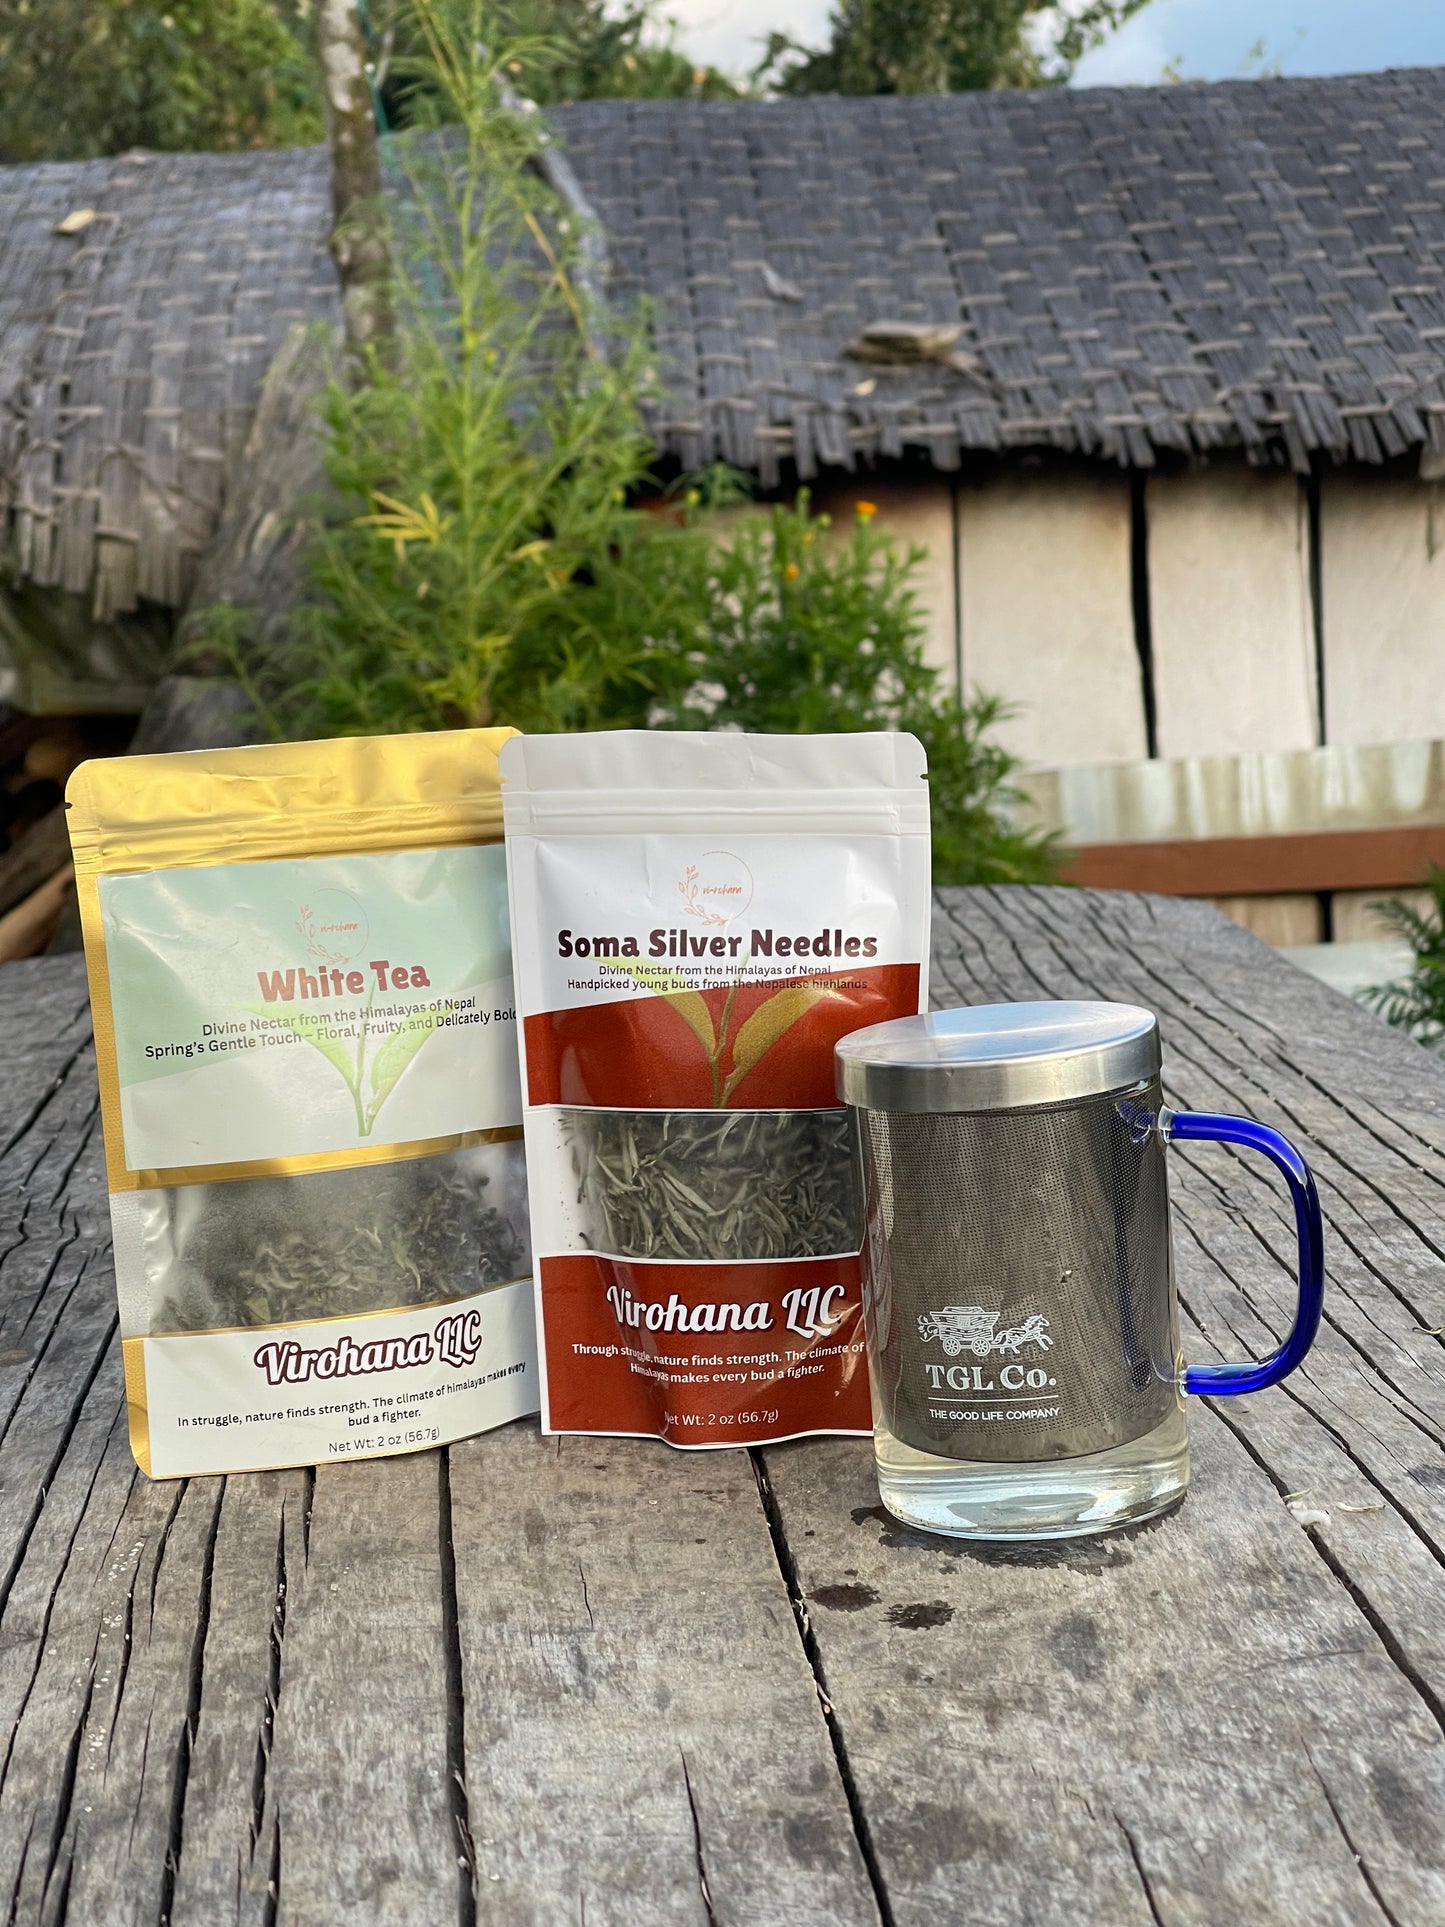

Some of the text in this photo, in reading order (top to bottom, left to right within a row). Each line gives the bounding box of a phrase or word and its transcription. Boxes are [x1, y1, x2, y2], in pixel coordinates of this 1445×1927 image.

[558, 928, 878, 958] Soma Silver Needles
[257, 960, 431, 1003] White Tea
[567, 978, 868, 992] Handpicked young buds from the Nepalese highlands
[599, 965, 831, 978] Divine Nectar from the Himalayas of Nepal
[202, 996, 476, 1036] Divine Nectar from the Himalayas of Nepal
[208, 1036, 257, 1052] Gentle
[259, 1030, 302, 1046] Touch
[317, 1026, 360, 1041] Floral,
[364, 1020, 406, 1036] Fruity,
[409, 1015, 433, 1030] and
[437, 1009, 490, 1027] Delicately
[606, 1284, 845, 1339] Virohana LLC
[254, 1309, 482, 1385] Virohana LLC
[571, 1341, 865, 1366] Through struggle, nature finds strength. The climate of
[630, 1363, 825, 1384] Himalayas makes every bud a fighter.
[925, 1364, 1057, 1391] TGL Co.
[178, 1361, 526, 1427] In struggle, nature finds strength. The climate of himalayas makes every
[348, 1408, 421, 1427] bud a fighter.
[664, 1409, 779, 1426] Net Wt: 2 oz (56.7g)
[929, 1407, 1060, 1421] THE GOOD LIFE COMPANY
[329, 1427, 440, 1454] Net Wt: 2 oz (56.7g)
